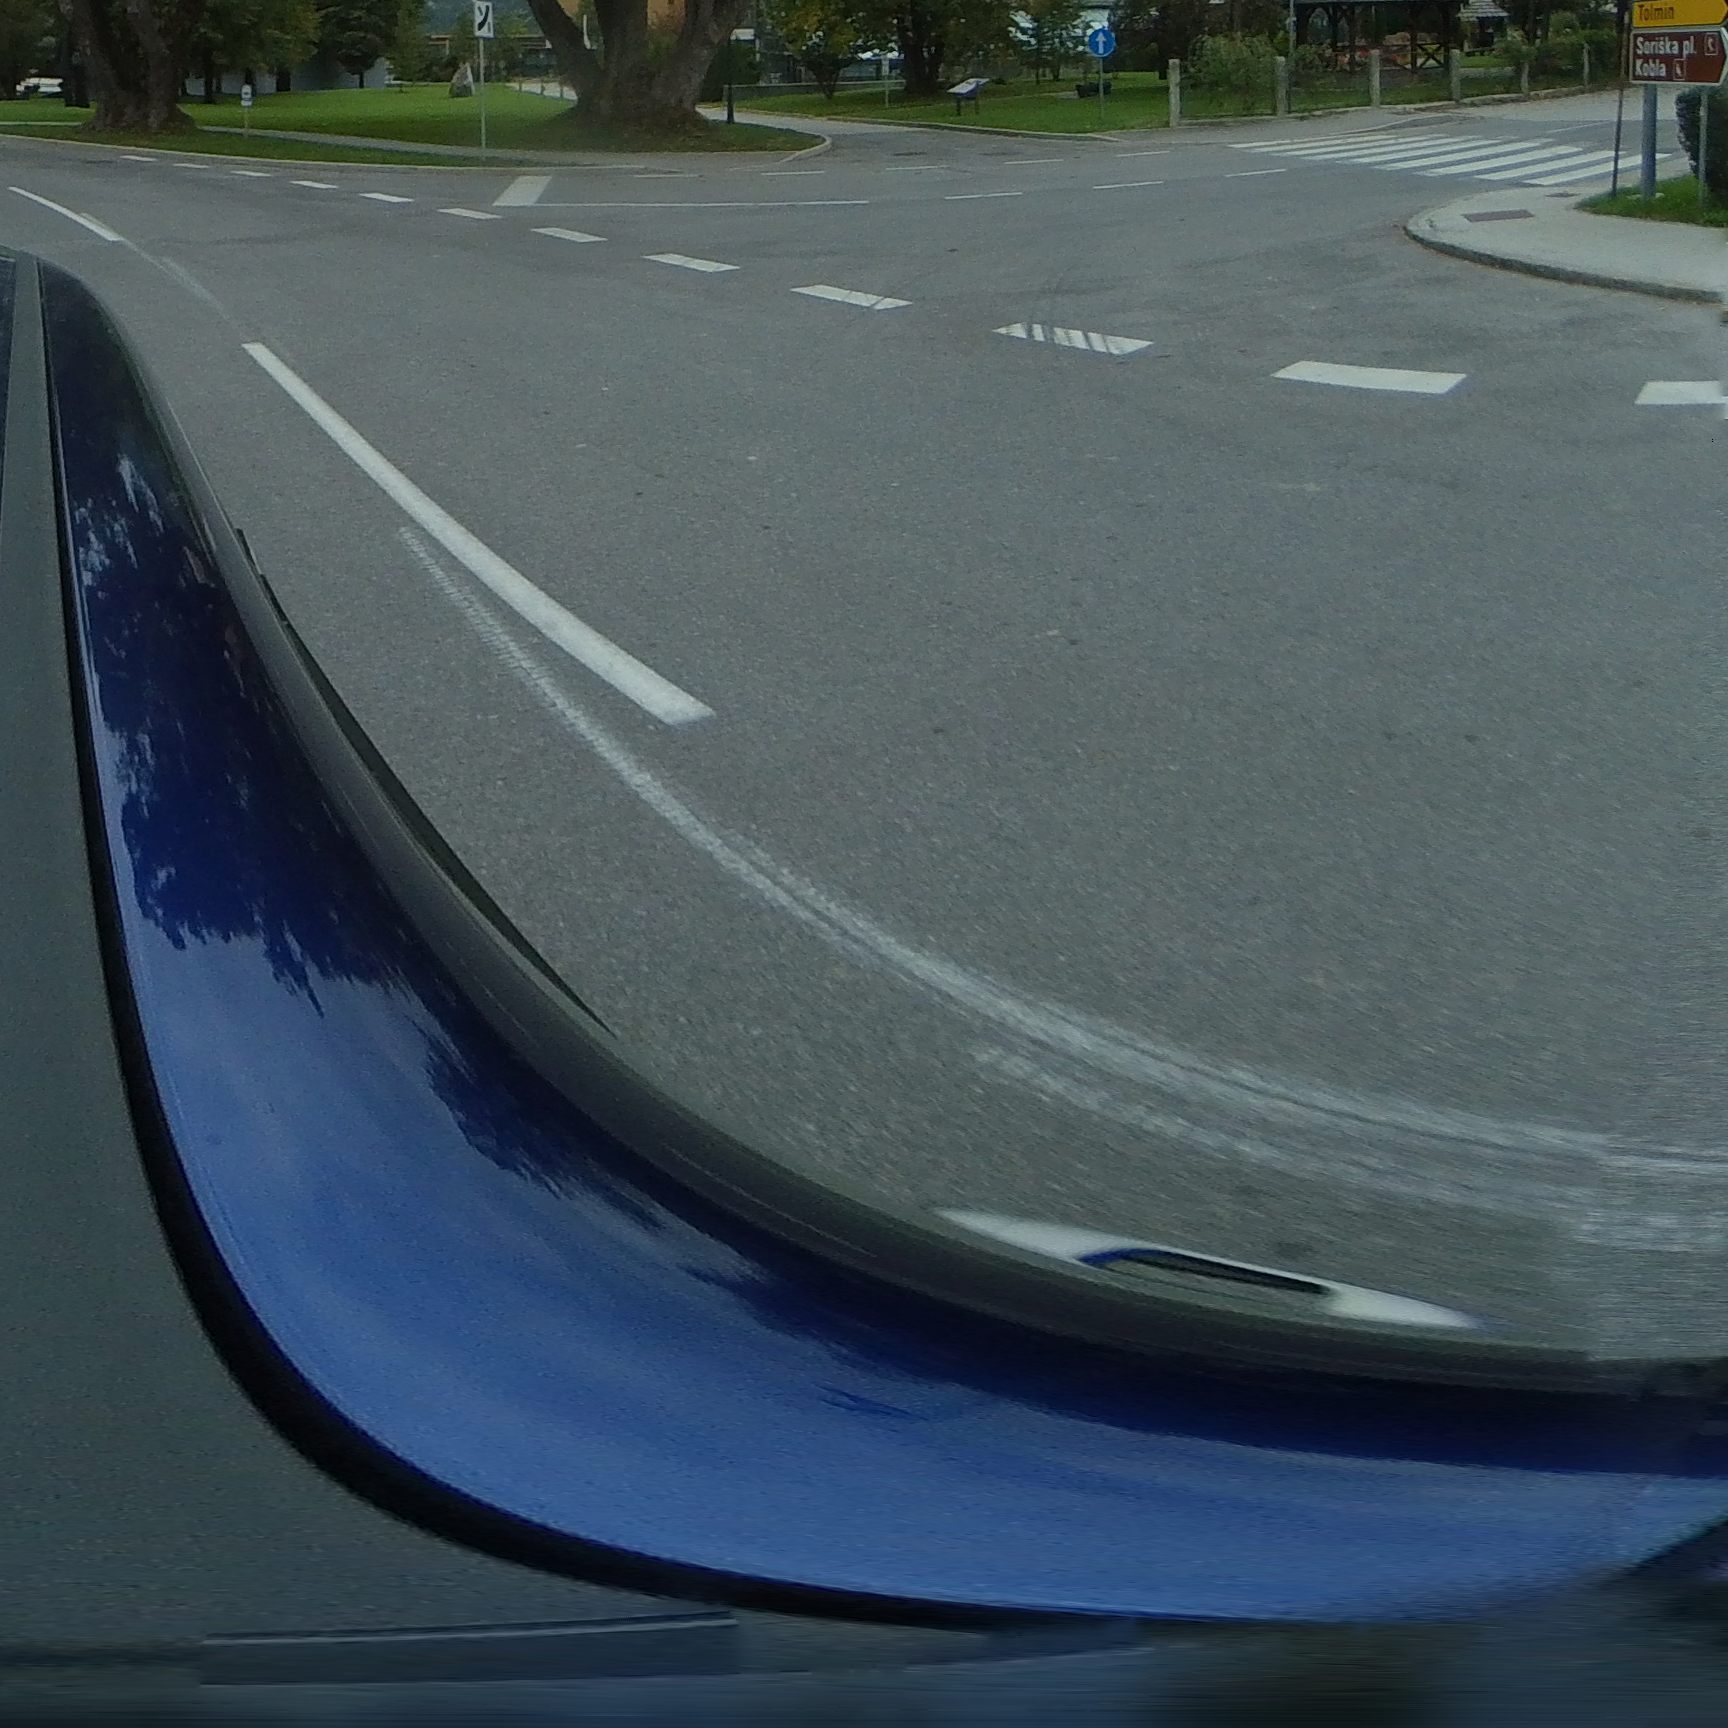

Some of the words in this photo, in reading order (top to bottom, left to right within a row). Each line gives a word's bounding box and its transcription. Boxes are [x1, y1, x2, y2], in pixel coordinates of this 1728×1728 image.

[1638, 3, 1675, 21] Tolmin
[1636, 36, 1679, 55] Soriška
[1682, 35, 1697, 60] pl.
[1635, 58, 1667, 77] Kobla
